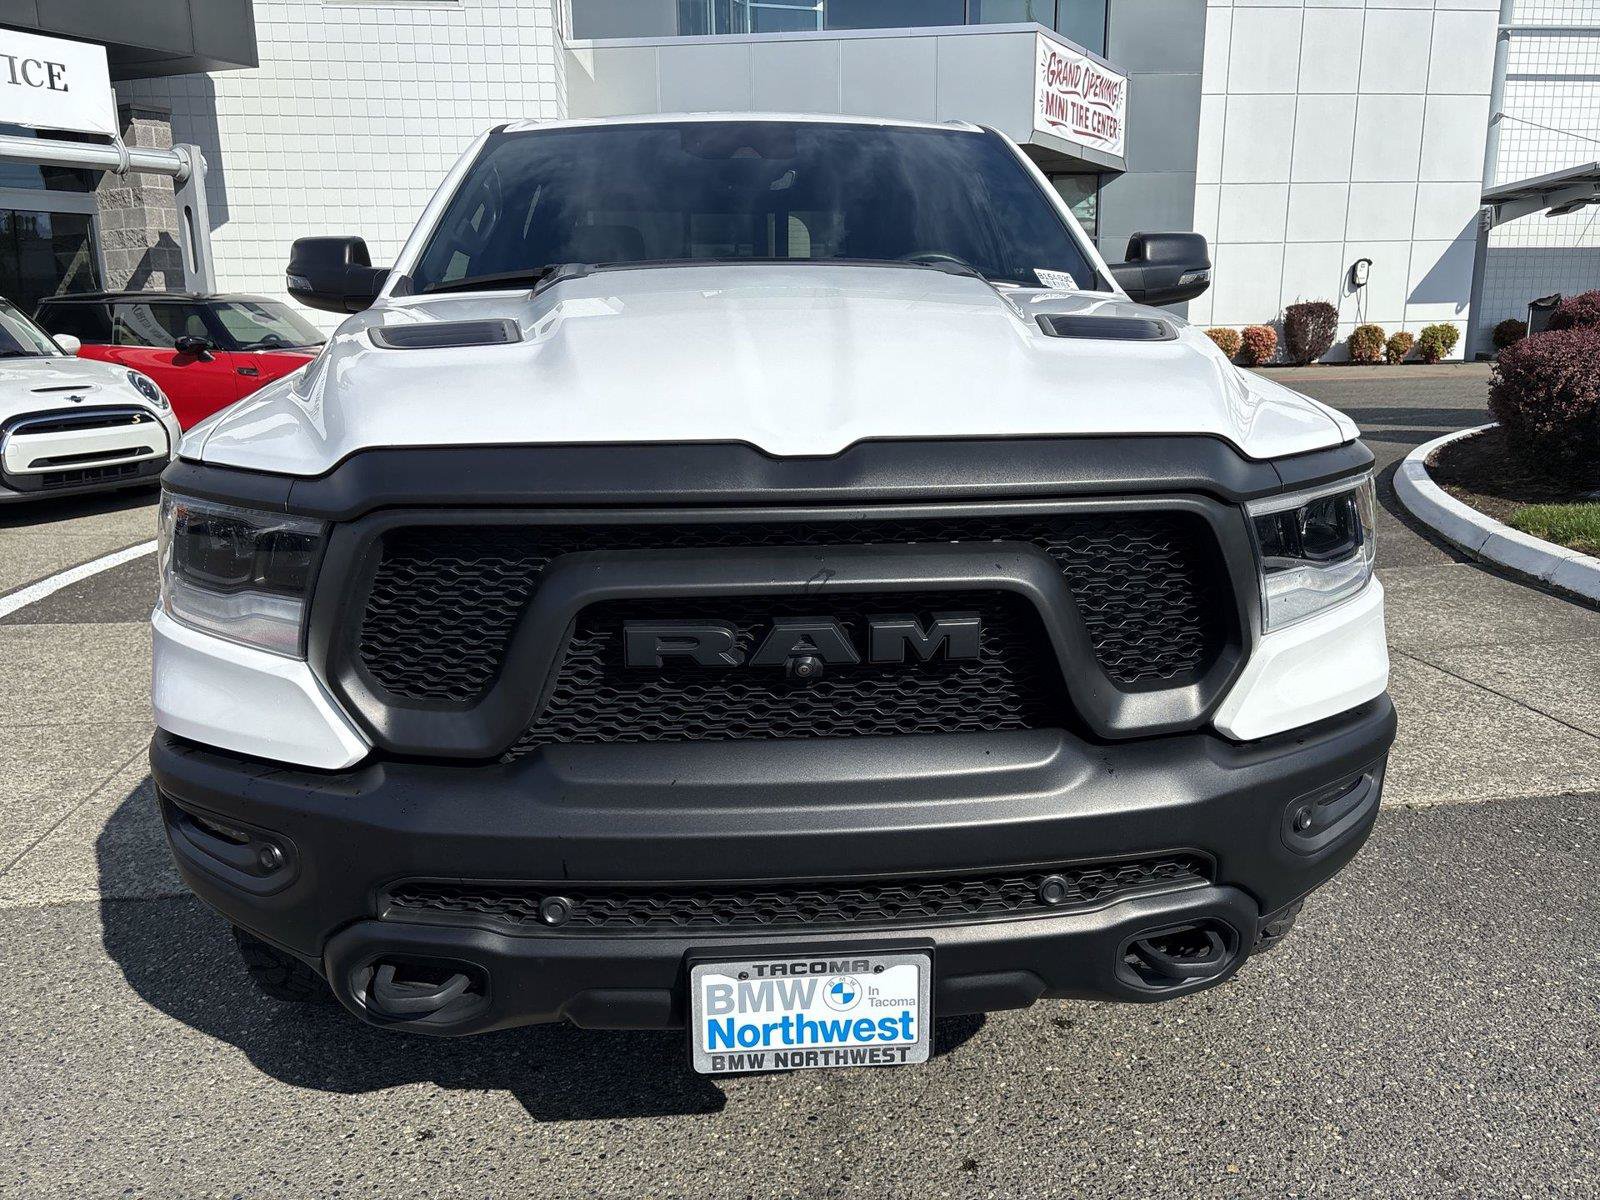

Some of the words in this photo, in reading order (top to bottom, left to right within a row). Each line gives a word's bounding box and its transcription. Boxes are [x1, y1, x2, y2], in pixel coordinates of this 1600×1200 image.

[0, 54, 68, 92] ICE
[1047, 51, 1082, 89] GRAND
[1081, 66, 1121, 110] OPENING!
[1045, 90, 1068, 122] MINI
[1071, 101, 1089, 129] TIRE
[1091, 110, 1118, 139] CENTER
[623, 611, 981, 667] RAM
[753, 959, 870, 977] TACOMA
[706, 978, 819, 1015] BMW
[868, 985, 879, 996] In
[868, 997, 916, 1007] Tacoma
[707, 1010, 914, 1050] Northwest
[712, 1053, 765, 1071] BMW
[774, 1046, 911, 1069] NORTHWEST
